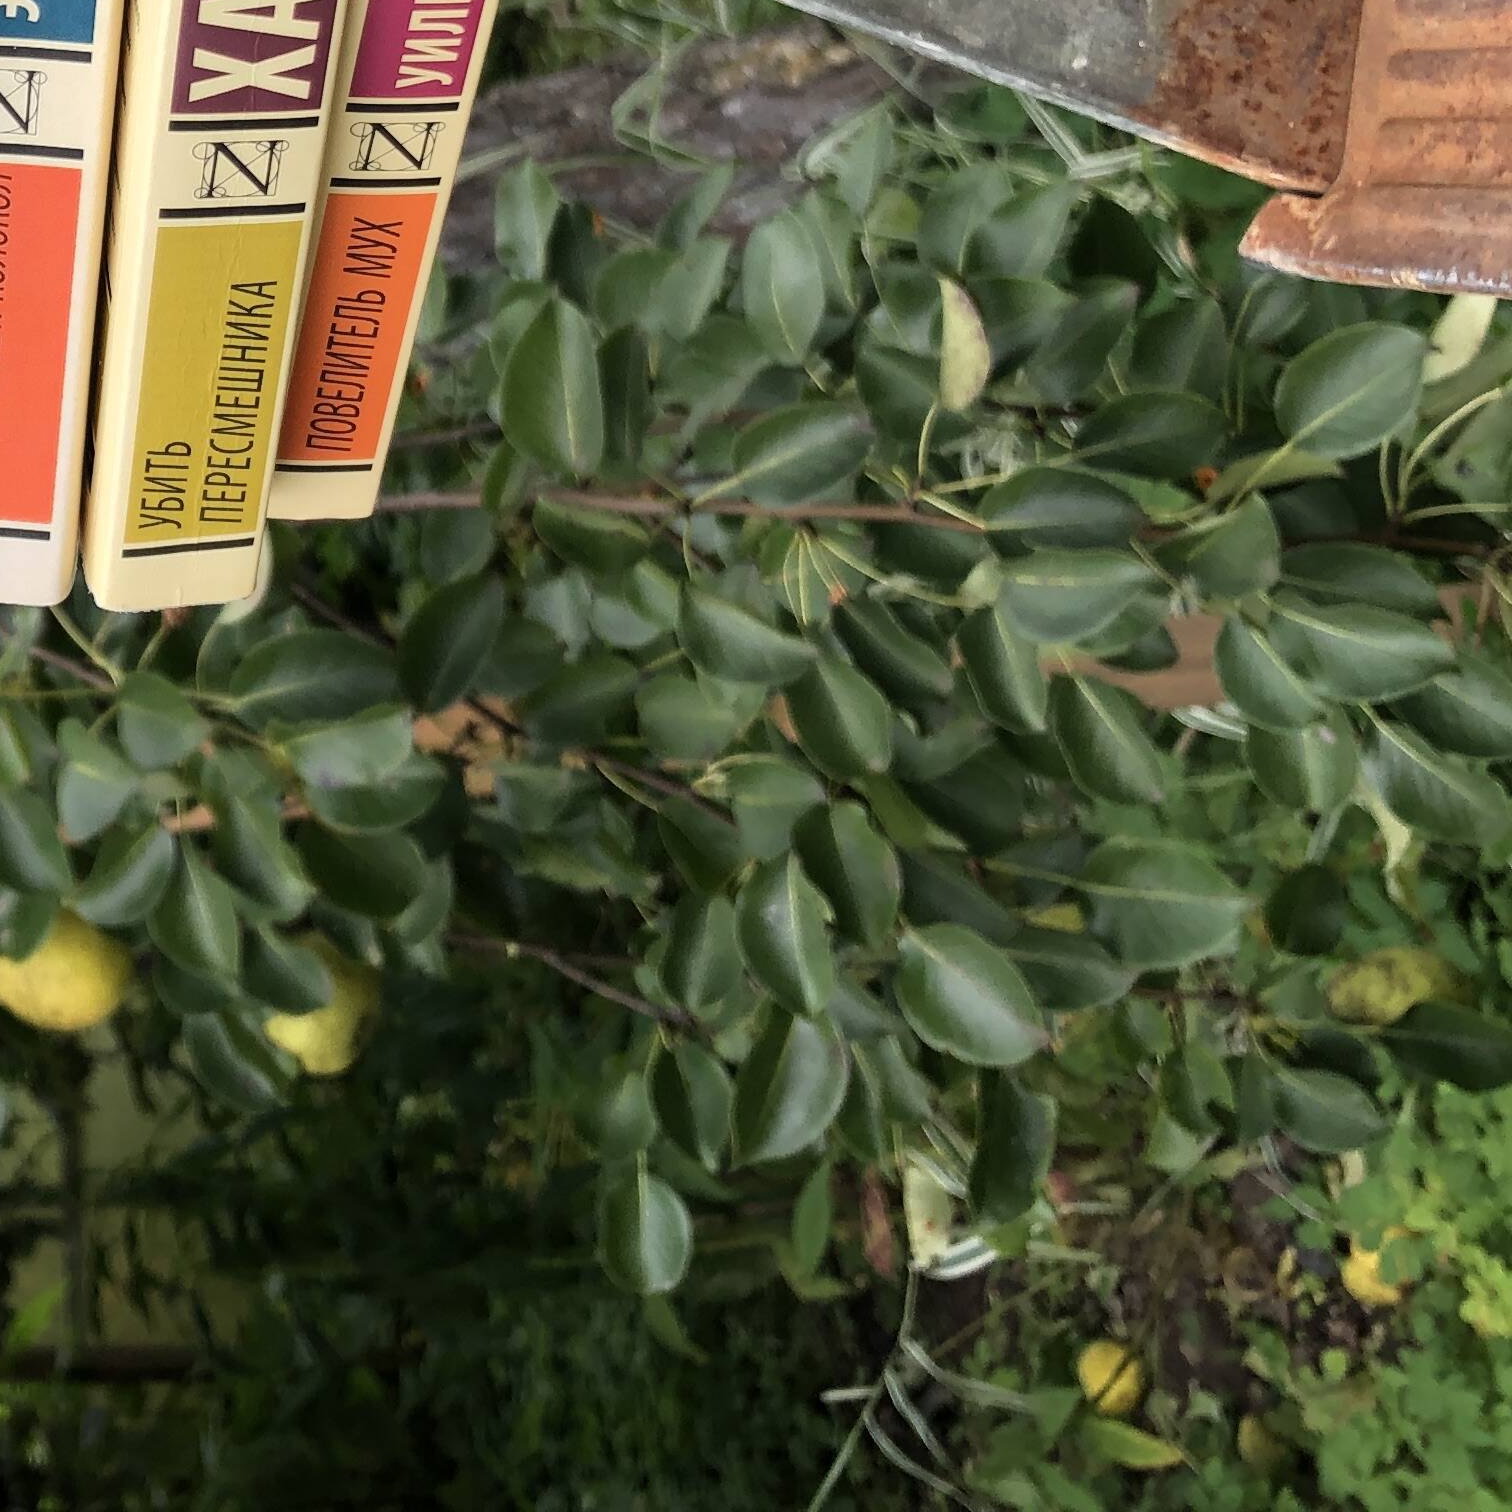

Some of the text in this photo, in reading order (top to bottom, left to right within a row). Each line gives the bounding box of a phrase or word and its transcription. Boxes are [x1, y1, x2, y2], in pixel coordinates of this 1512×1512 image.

[199, 279, 279, 526] ПЕРЕСМЕШНИКА
[305, 217, 405, 452] ПОВЕЛИТЕЛЬ МУХ
[138, 440, 192, 530] УБИТЬ
